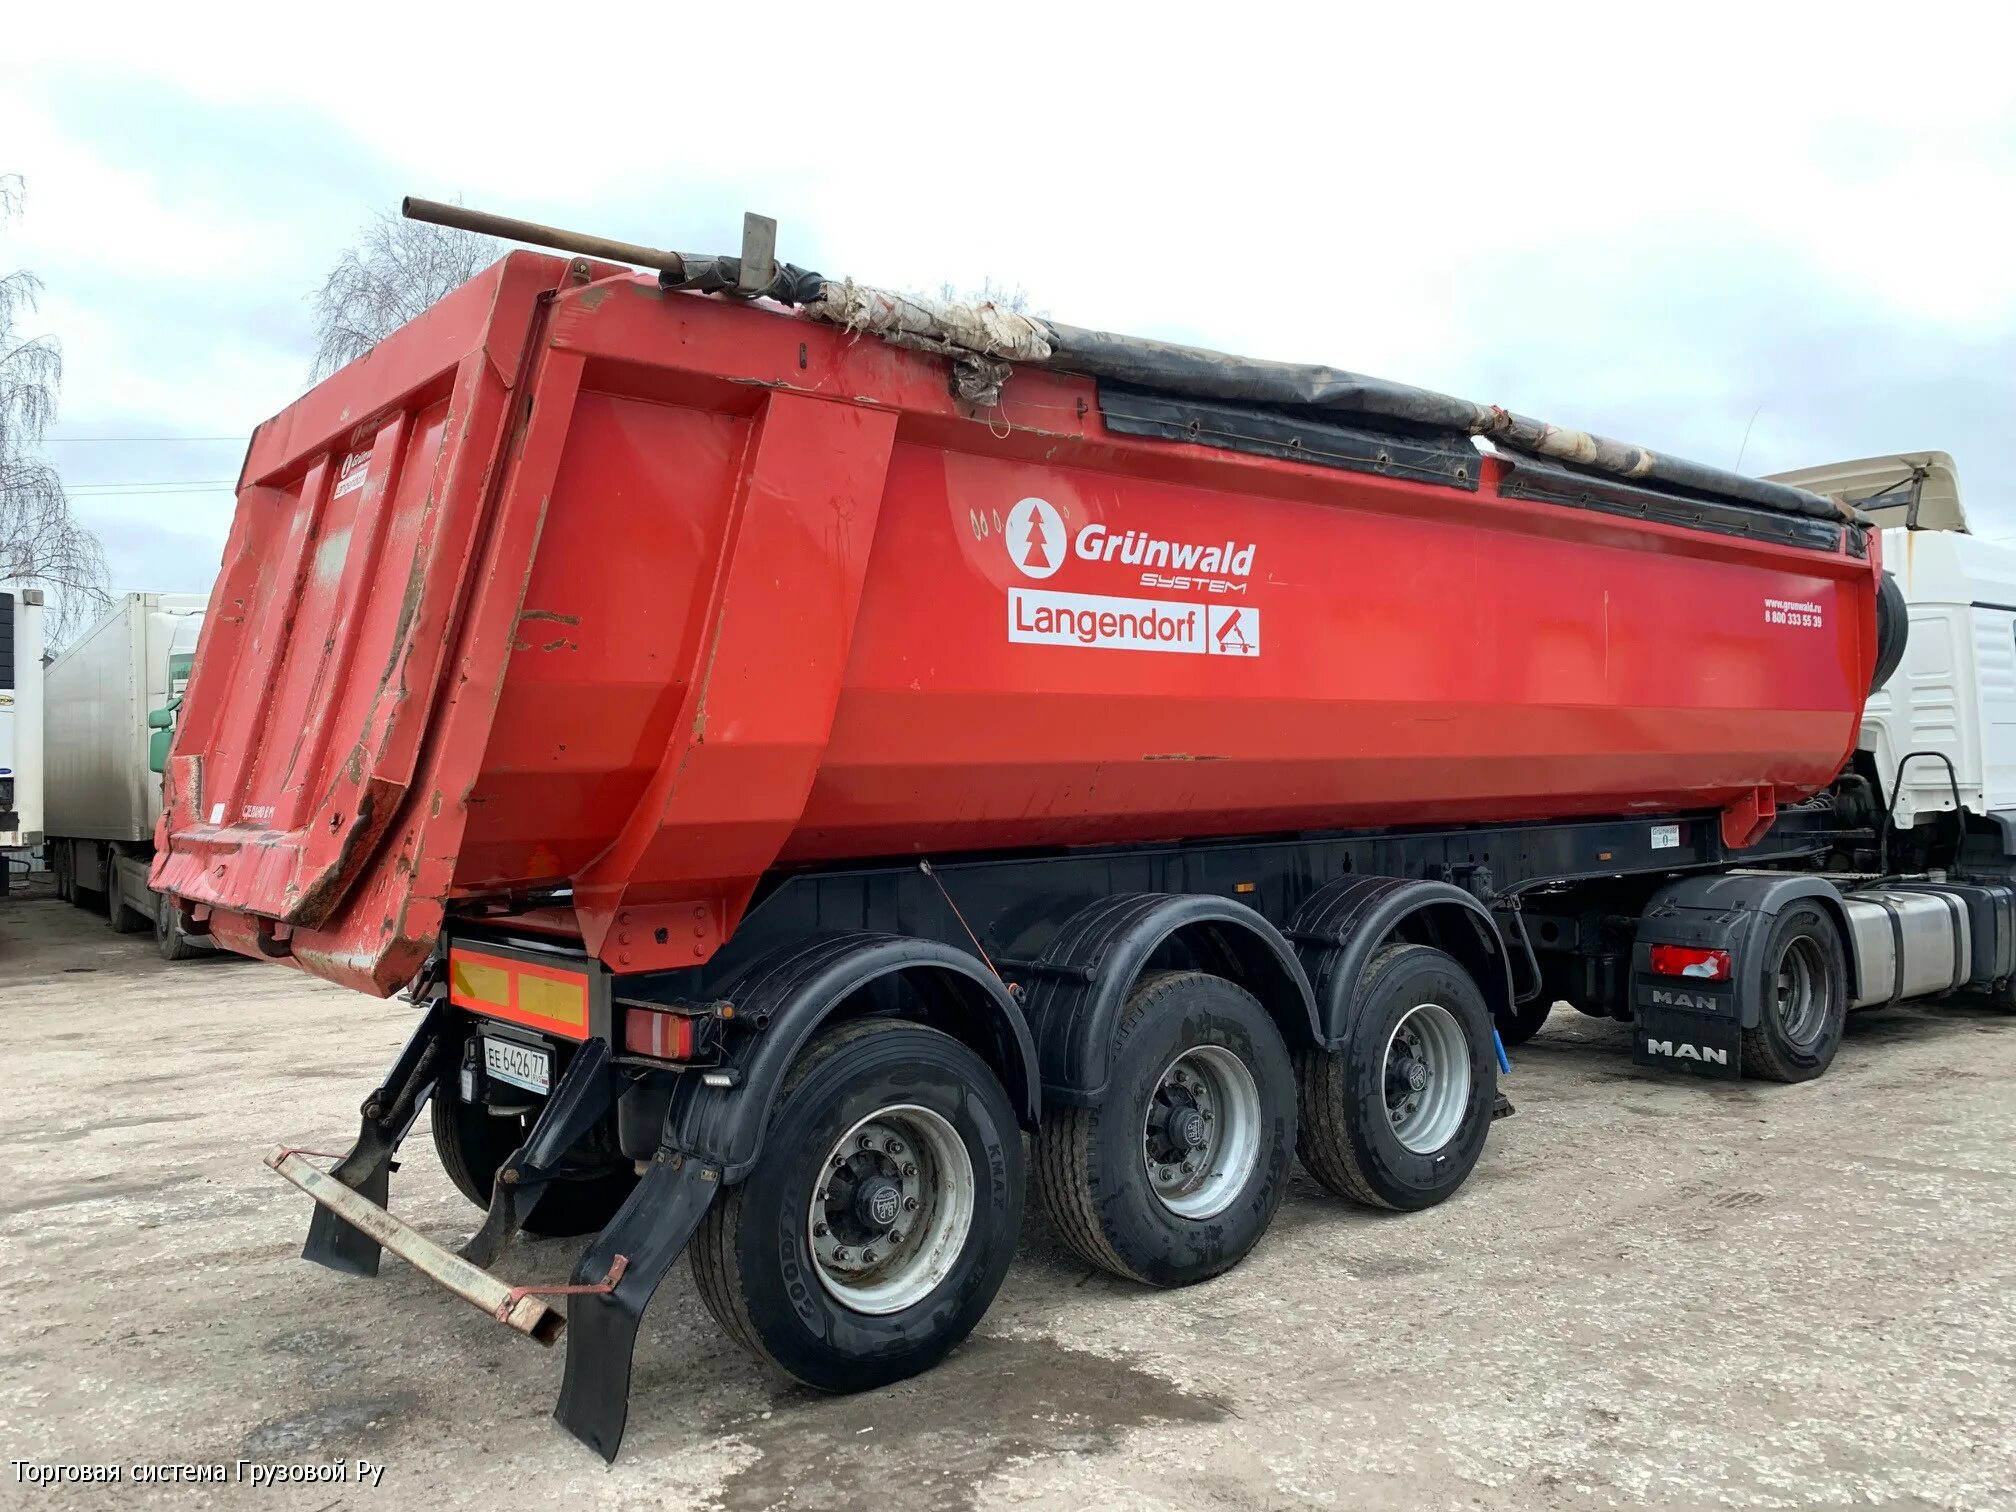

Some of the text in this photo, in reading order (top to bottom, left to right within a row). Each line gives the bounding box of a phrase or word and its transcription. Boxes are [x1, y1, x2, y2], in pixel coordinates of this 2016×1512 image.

[1075, 523, 1256, 577] Grünwald
[1139, 572, 1248, 595] SYSTEM
[1764, 598, 1822, 614] www.grunwald.ru
[1016, 596, 1196, 643] Langendorf
[1765, 610, 1822, 628] 8 800 333 55 39
[1652, 990, 1717, 1011] MAN
[1647, 1038, 1727, 1066] MAN
[532, 1054, 545, 1075] 77
